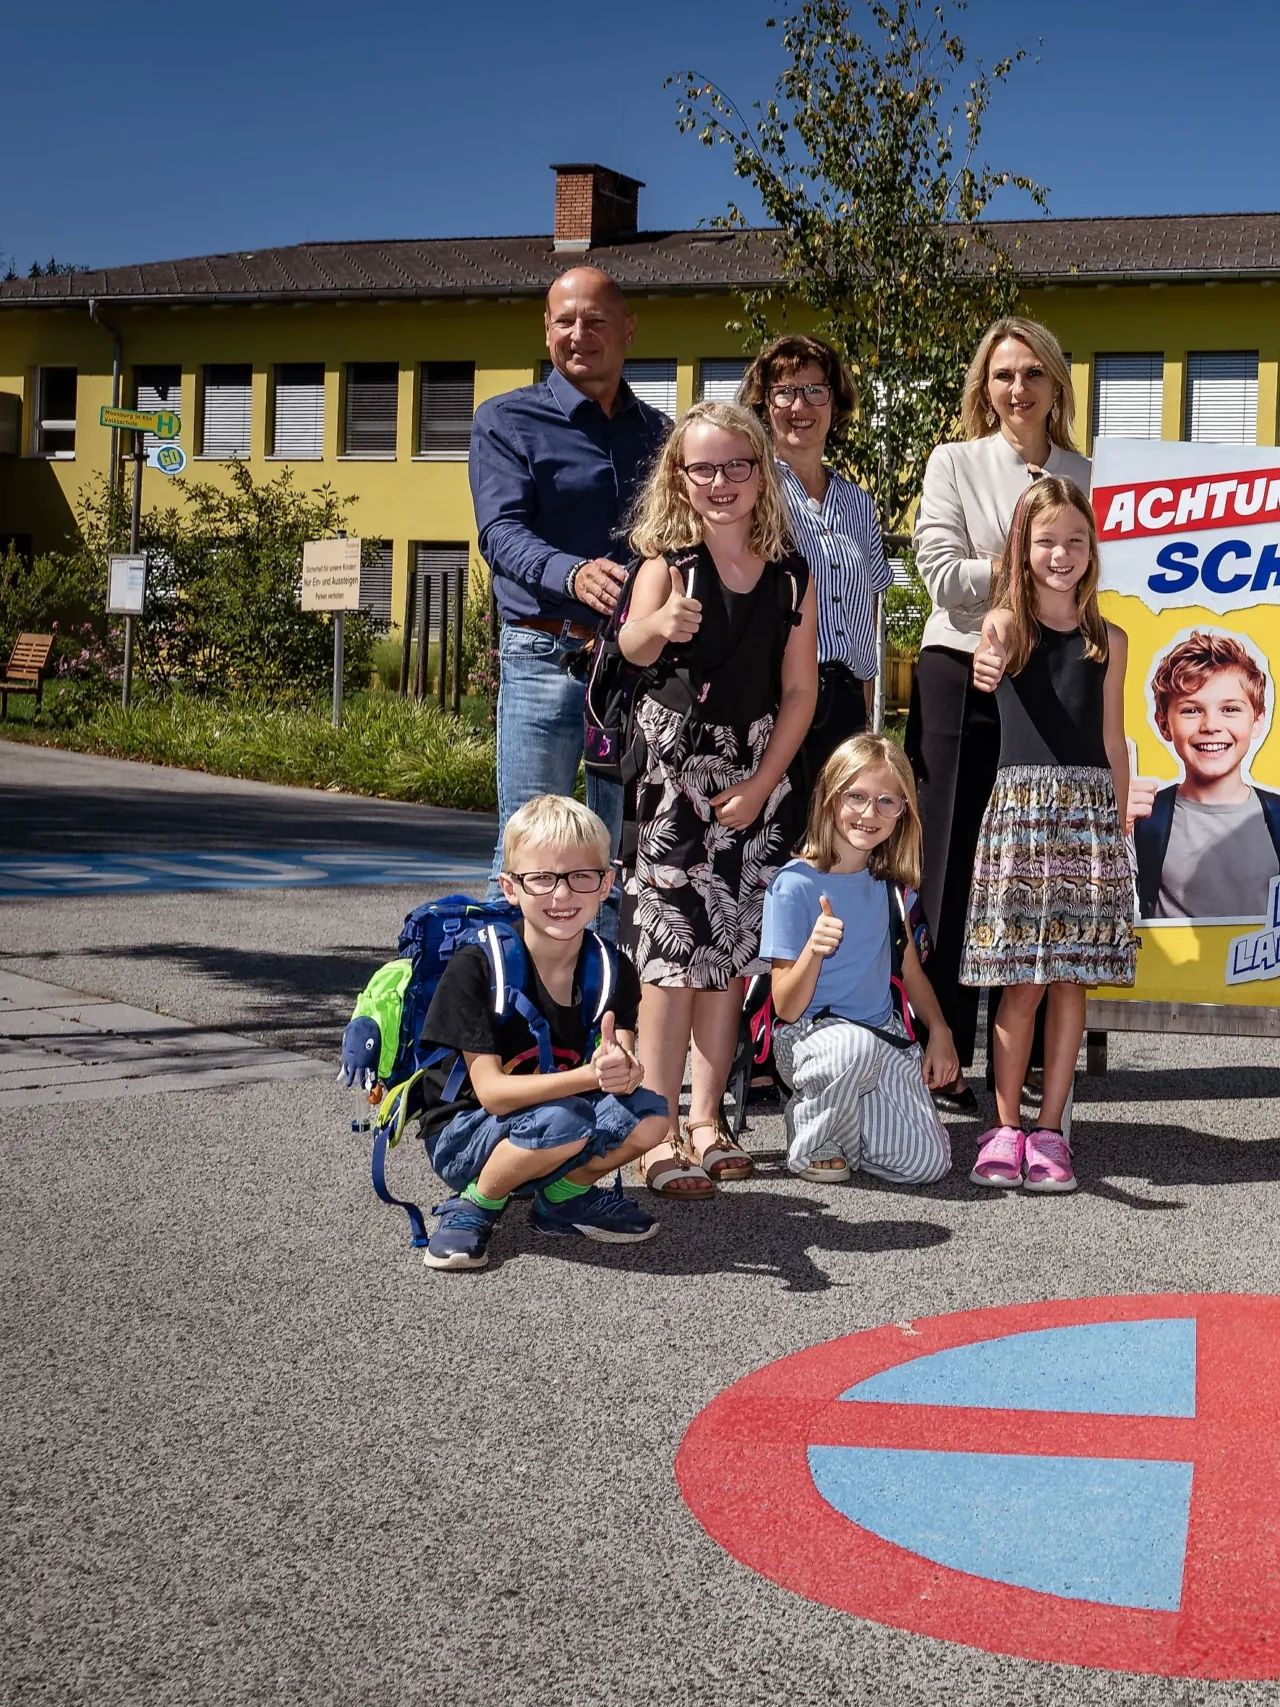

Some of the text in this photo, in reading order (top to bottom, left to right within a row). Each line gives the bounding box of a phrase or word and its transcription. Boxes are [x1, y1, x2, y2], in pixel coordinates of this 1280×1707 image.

[104, 409, 134, 420] Moosburg
[104, 417, 138, 426] Volksschule
[157, 414, 174, 434] H
[159, 449, 181, 466] GO
[322, 577, 331, 586] und
[332, 576, 358, 587] Aussteigen
